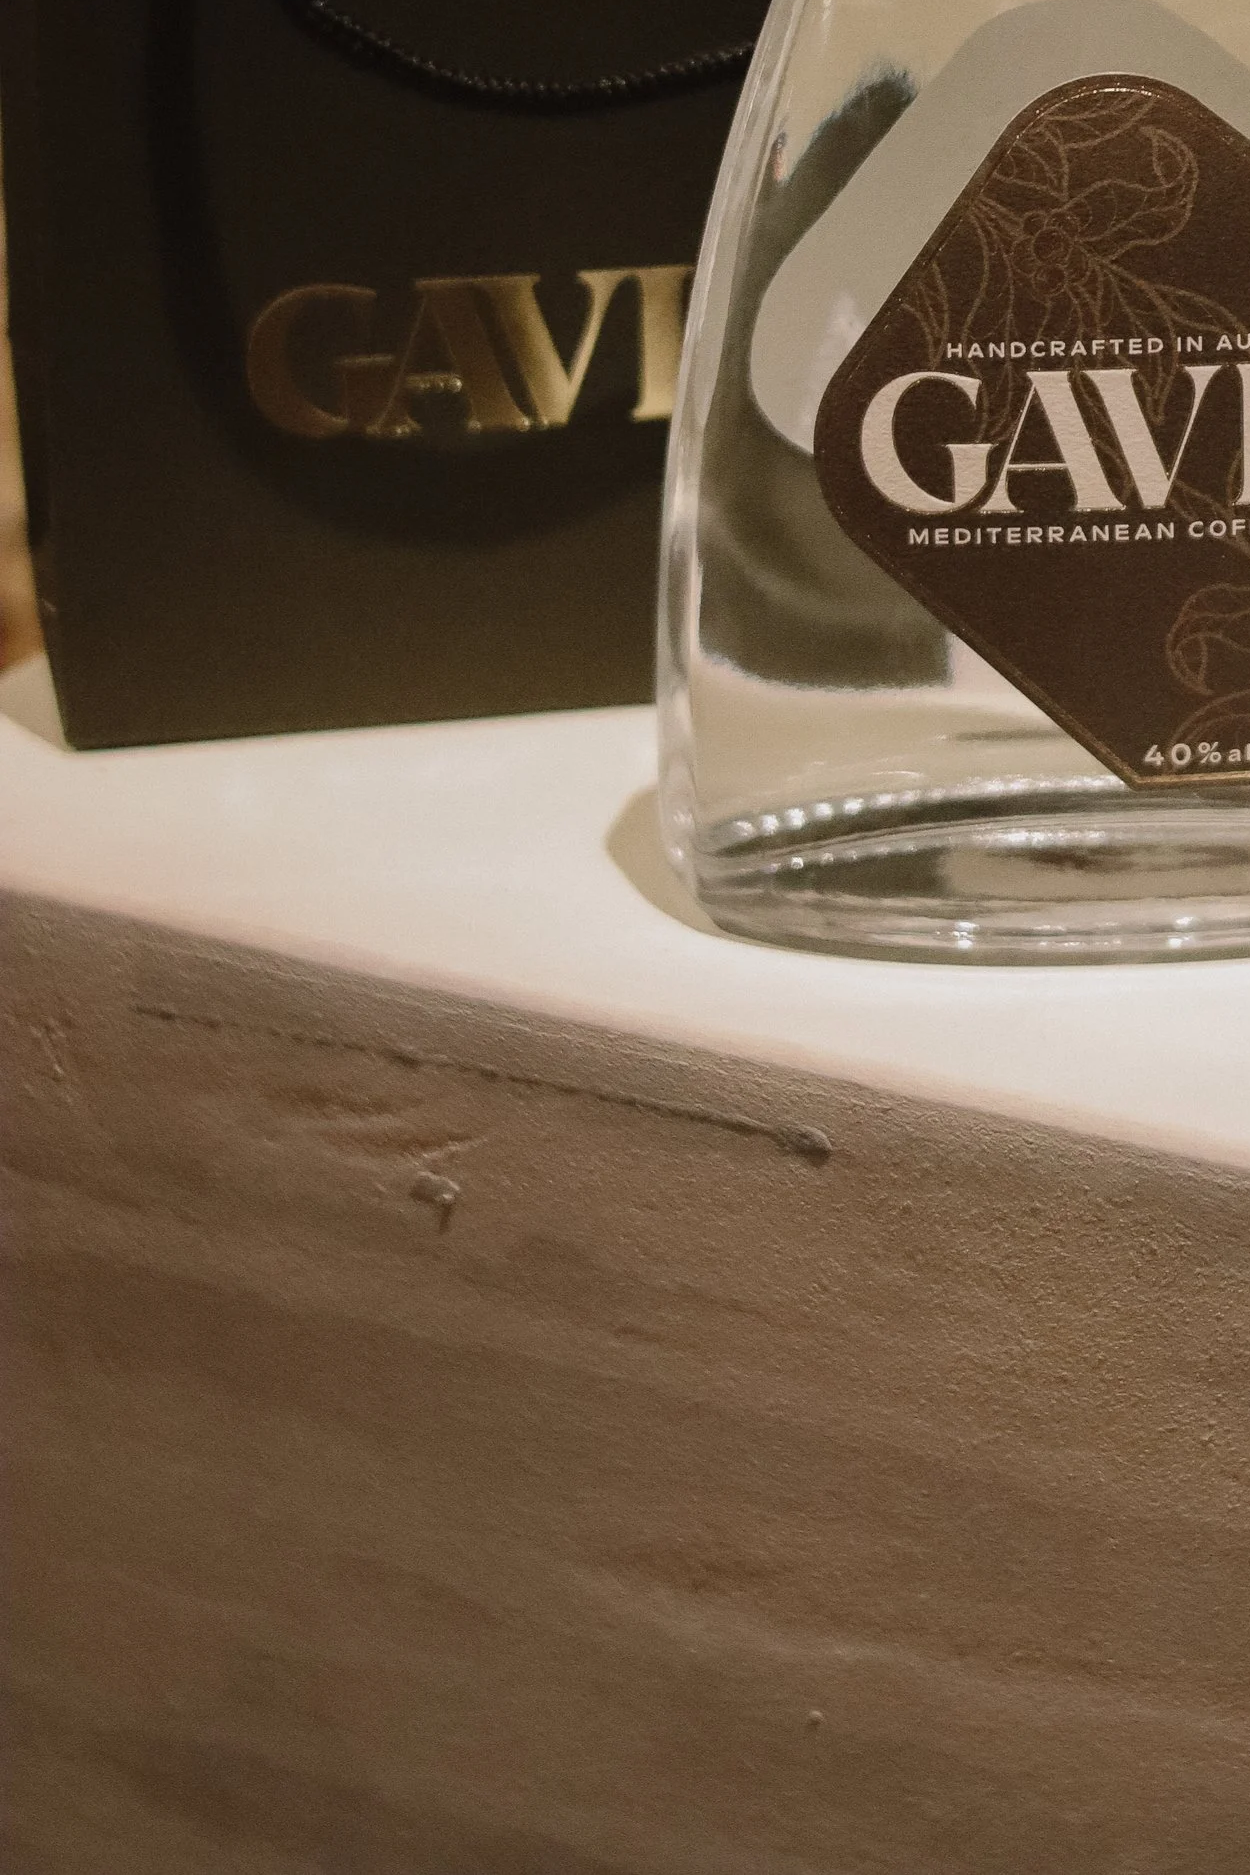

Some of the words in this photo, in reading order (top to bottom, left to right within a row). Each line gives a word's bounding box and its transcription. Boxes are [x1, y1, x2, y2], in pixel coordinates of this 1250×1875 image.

[246, 263, 697, 439] GAVI
[946, 336, 1164, 360] HANDCRAFTED
[1176, 334, 1203, 353] IN
[908, 521, 1175, 545] MEDITERRANEAN
